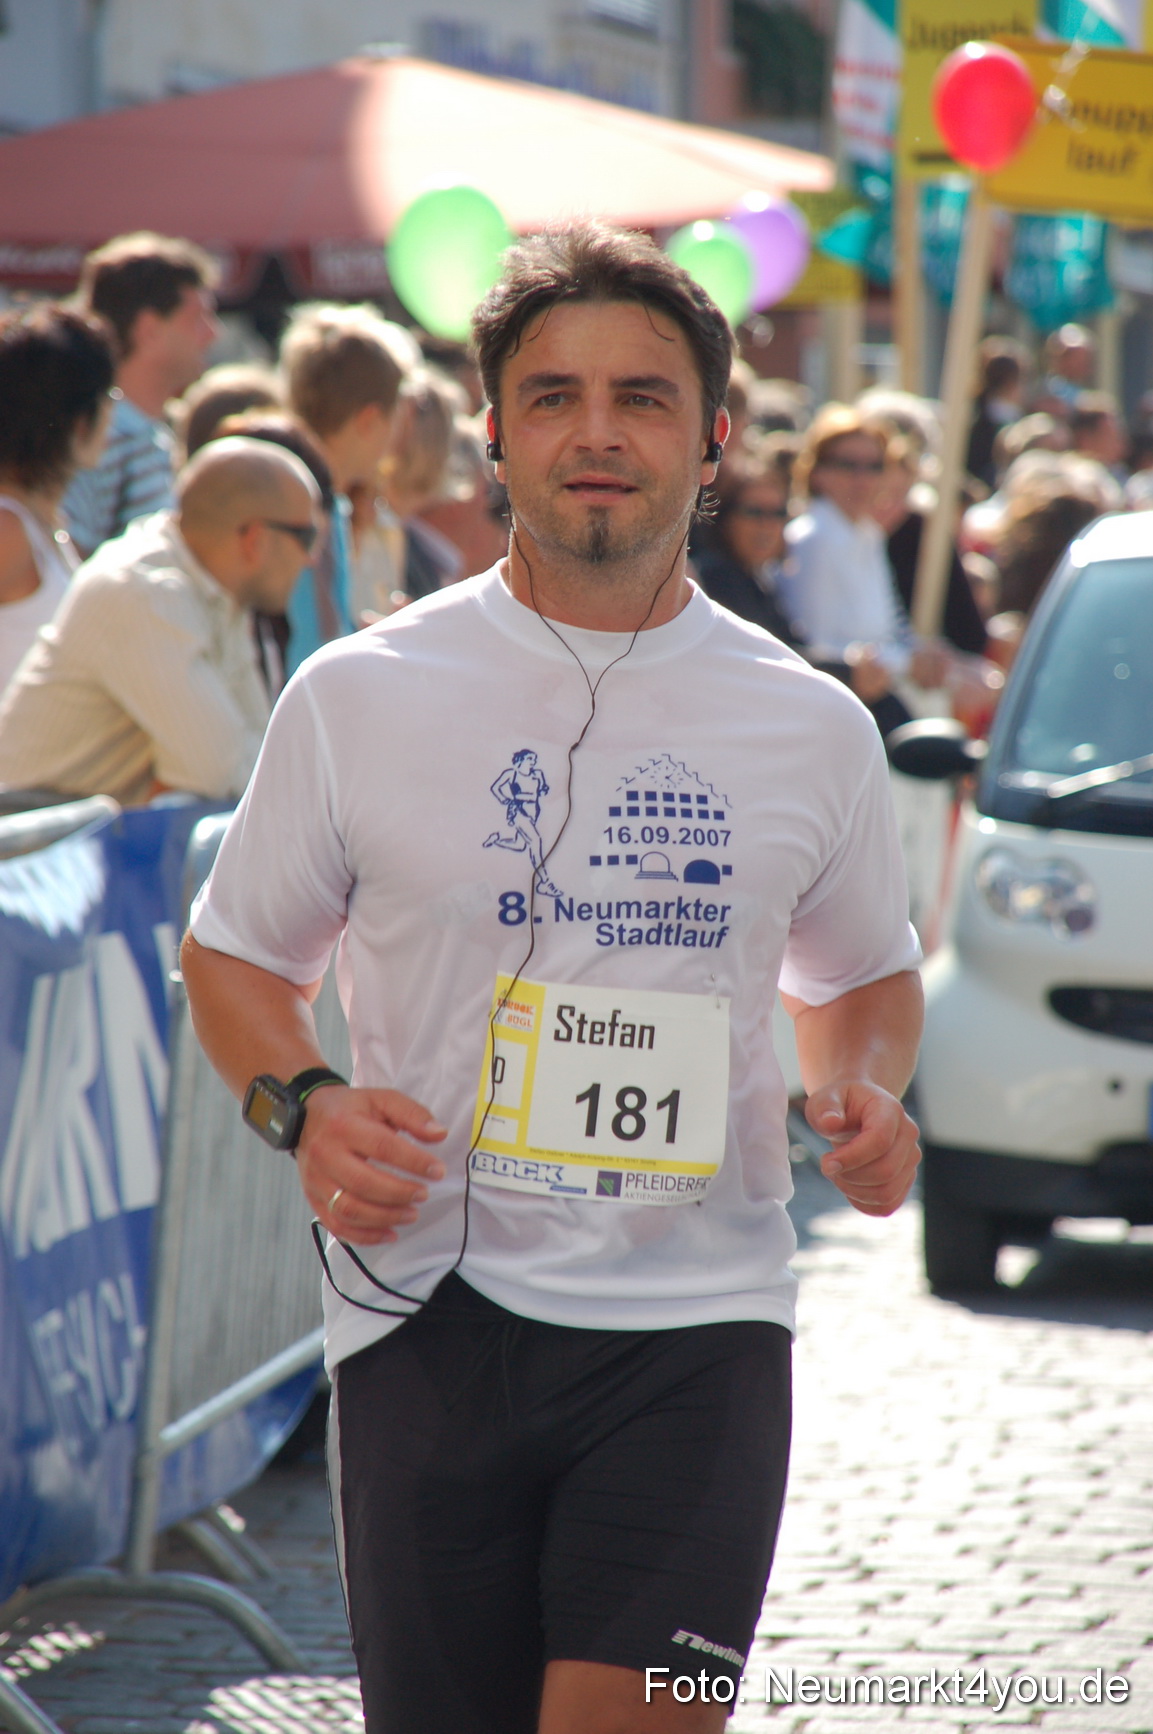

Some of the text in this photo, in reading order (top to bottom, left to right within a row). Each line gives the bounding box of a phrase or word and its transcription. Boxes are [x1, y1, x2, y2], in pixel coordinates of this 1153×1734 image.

[602, 825, 732, 848] 16.09.2007
[497, 890, 732, 927] 8. Neumarkter
[595, 922, 729, 949] Stadtlauf
[553, 1003, 656, 1050] Stefan
[575, 1082, 681, 1145] 181
[470, 1151, 565, 1184] BOCK
